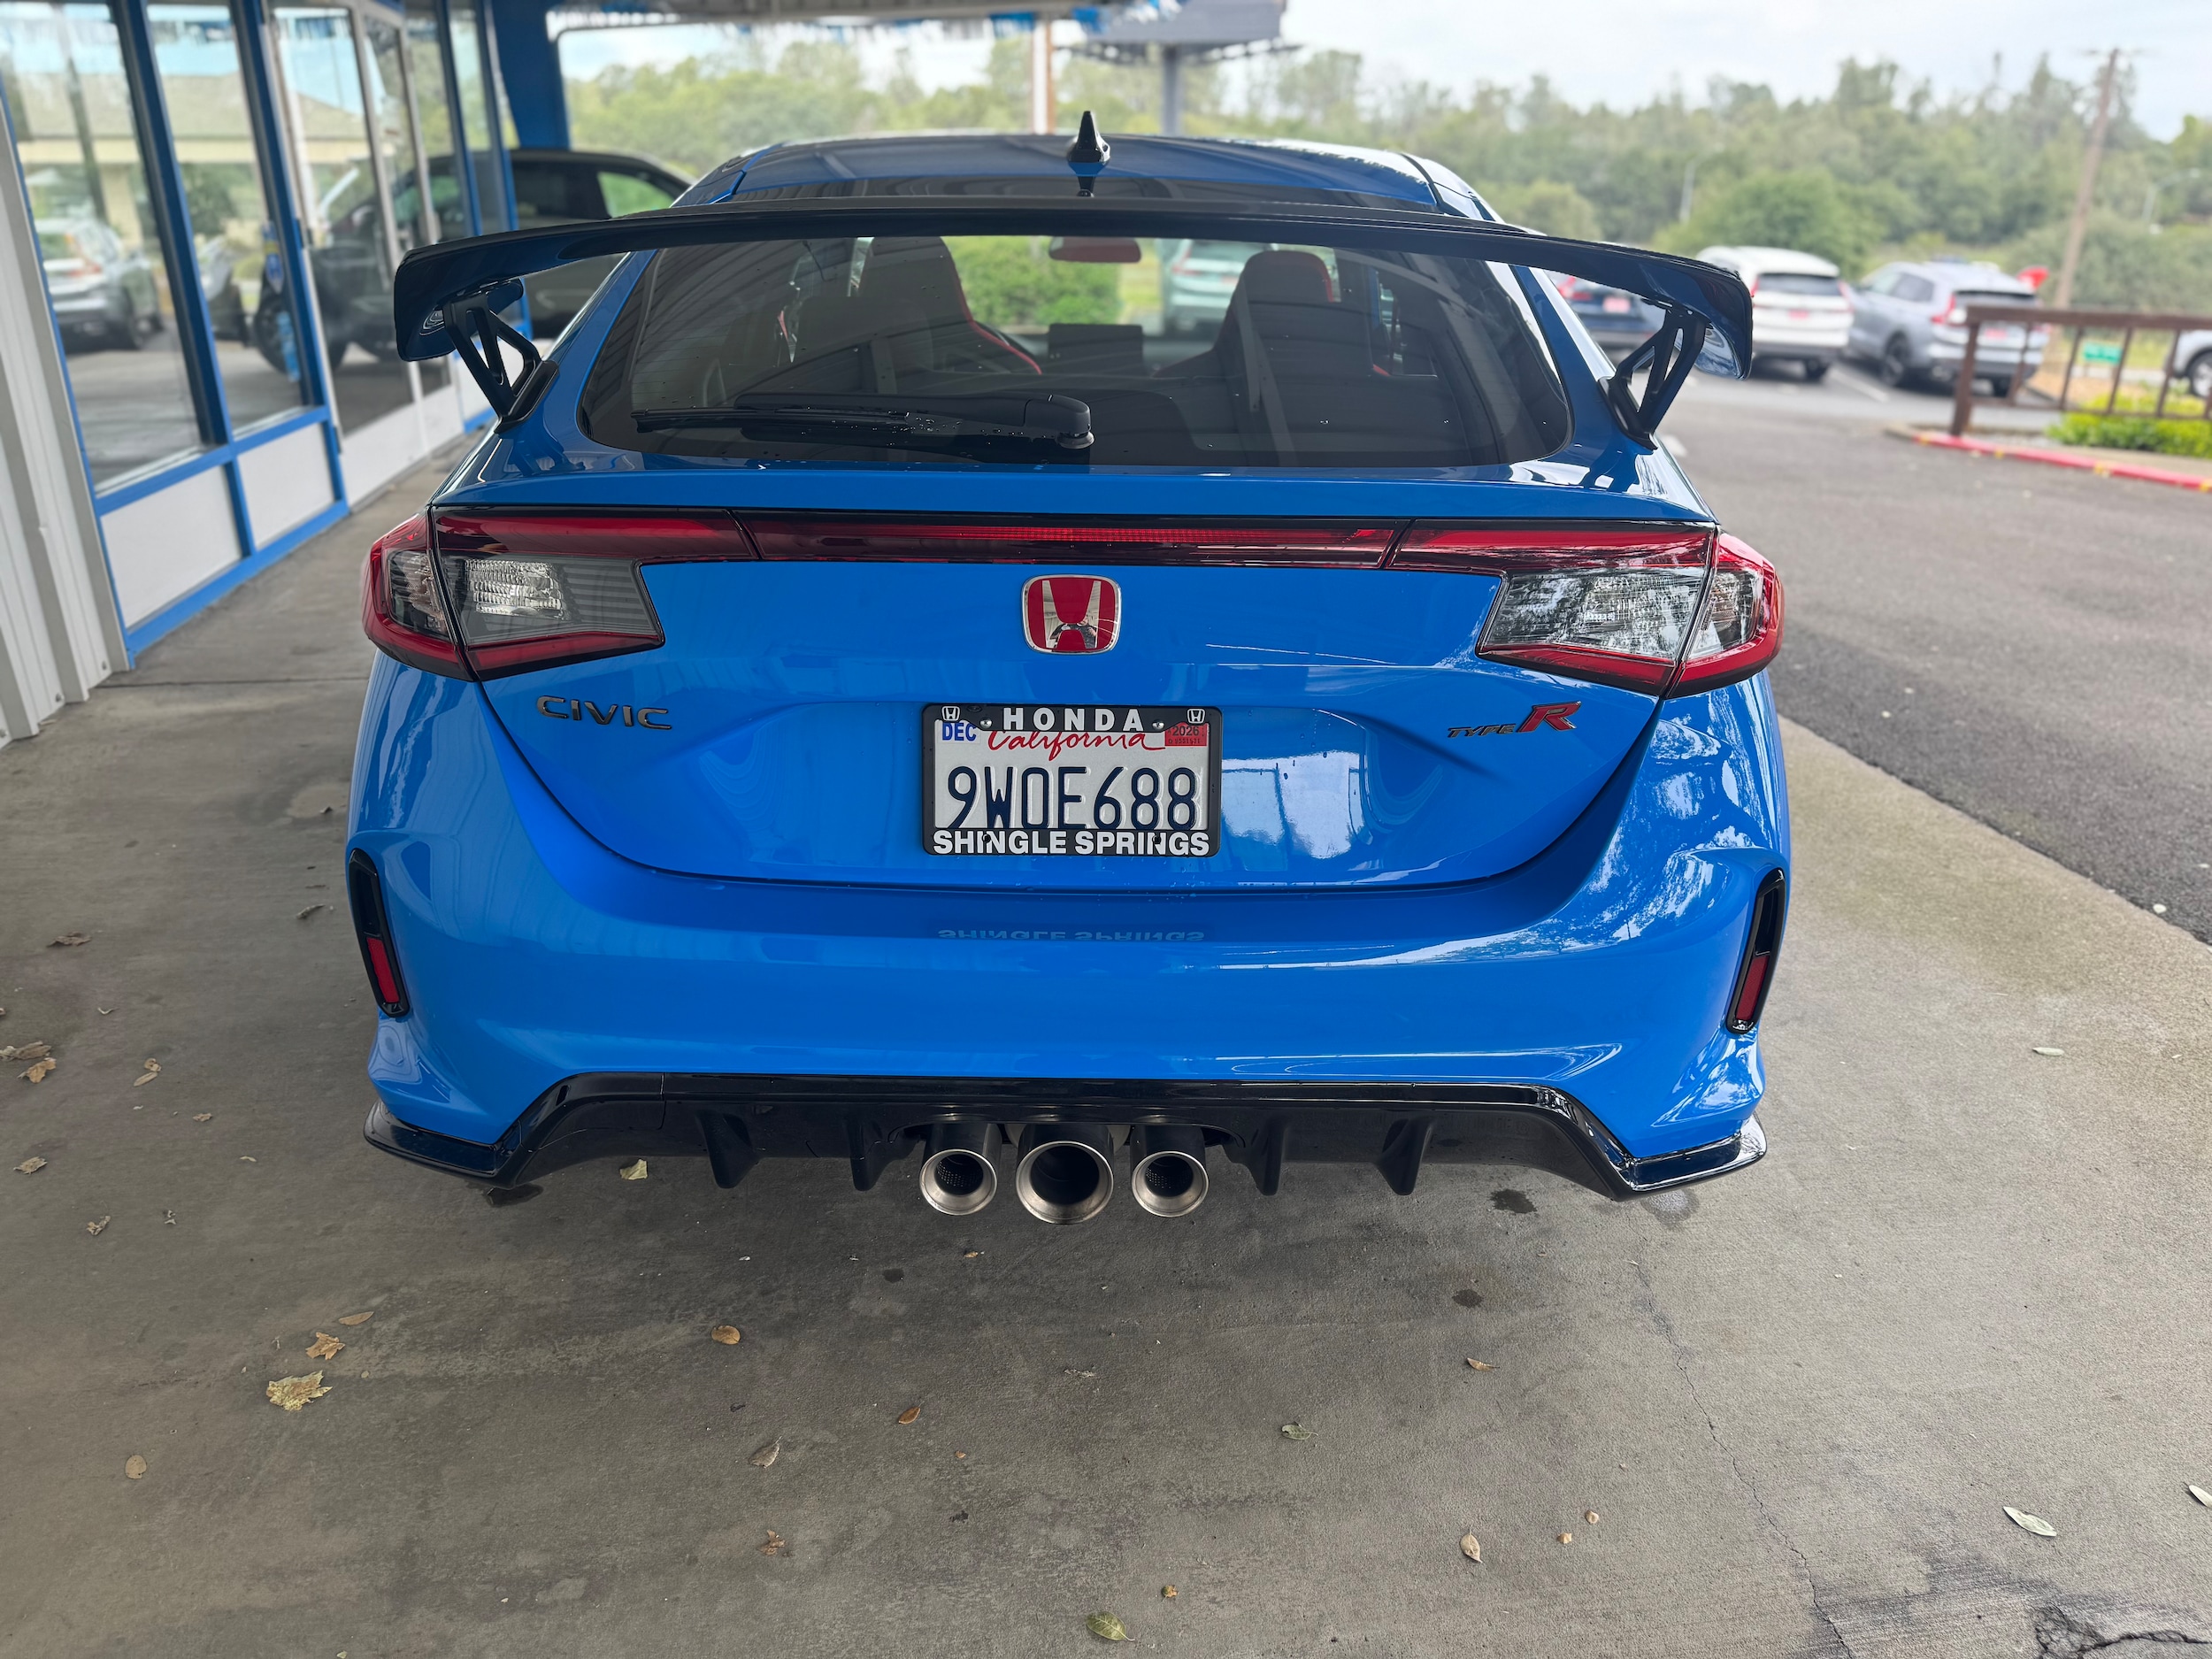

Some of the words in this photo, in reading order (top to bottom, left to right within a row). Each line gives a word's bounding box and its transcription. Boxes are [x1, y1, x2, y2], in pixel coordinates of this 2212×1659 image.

[537, 695, 672, 731] CIVIC
[1003, 707, 1144, 732] HONDA
[1448, 724, 1517, 739] TYPE
[1517, 700, 1582, 733] R
[941, 721, 977, 741] DEC
[1171, 725, 1200, 736] 2026
[987, 731, 1166, 761] California
[933, 830, 1067, 854] SHINGLE
[1074, 832, 1210, 856] SPRINGS
